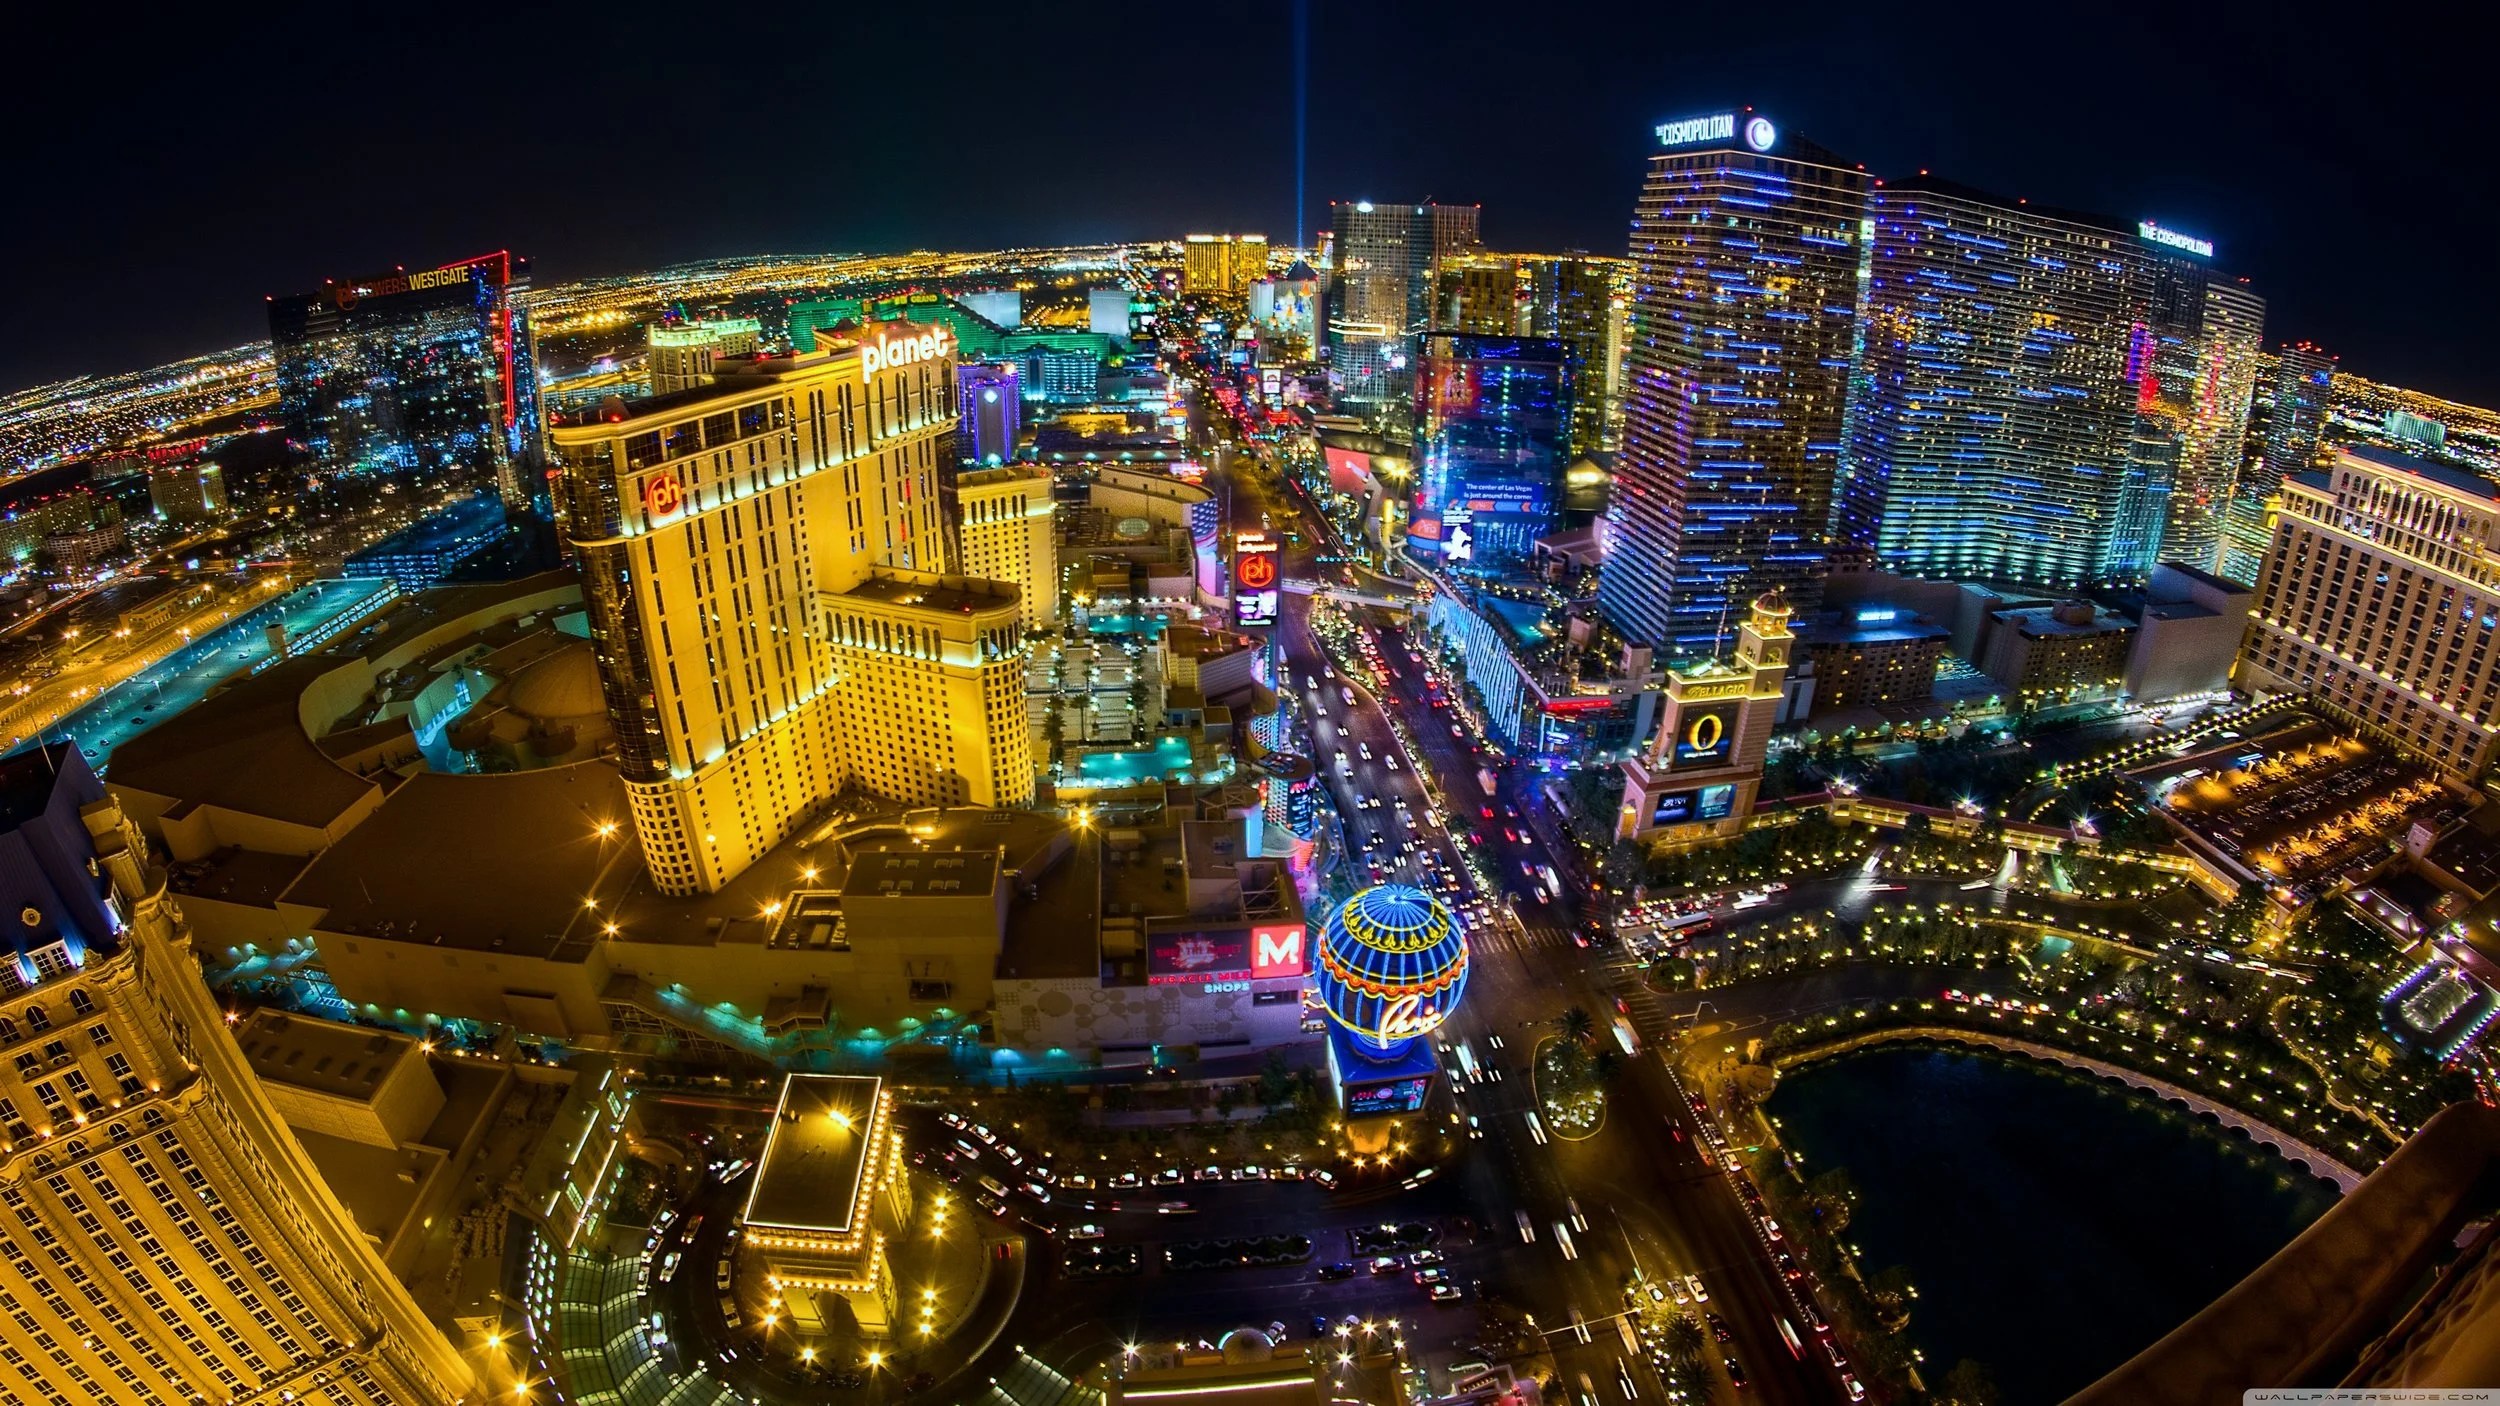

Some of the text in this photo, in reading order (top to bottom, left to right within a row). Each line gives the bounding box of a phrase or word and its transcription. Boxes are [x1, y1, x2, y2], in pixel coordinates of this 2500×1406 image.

[1662, 114, 1734, 145] COSMOPOLITAN
[2138, 222, 2213, 257] THE COSMOPOLITAN
[409, 266, 469, 290] WESTGATE
[910, 294, 938, 303] GRAND
[861, 327, 949, 384] planet
[653, 475, 680, 511] ph
[1515, 485, 1533, 493] Vegas
[1245, 555, 1273, 581] ph
[1688, 684, 1746, 697] BELLAGIO
[1689, 714, 1723, 751] O
[1258, 931, 1300, 967] M
[1150, 971, 1250, 985] MIRACLE MILE
[1203, 982, 1250, 994] SHOPS
[1379, 994, 1442, 1050] Paris
